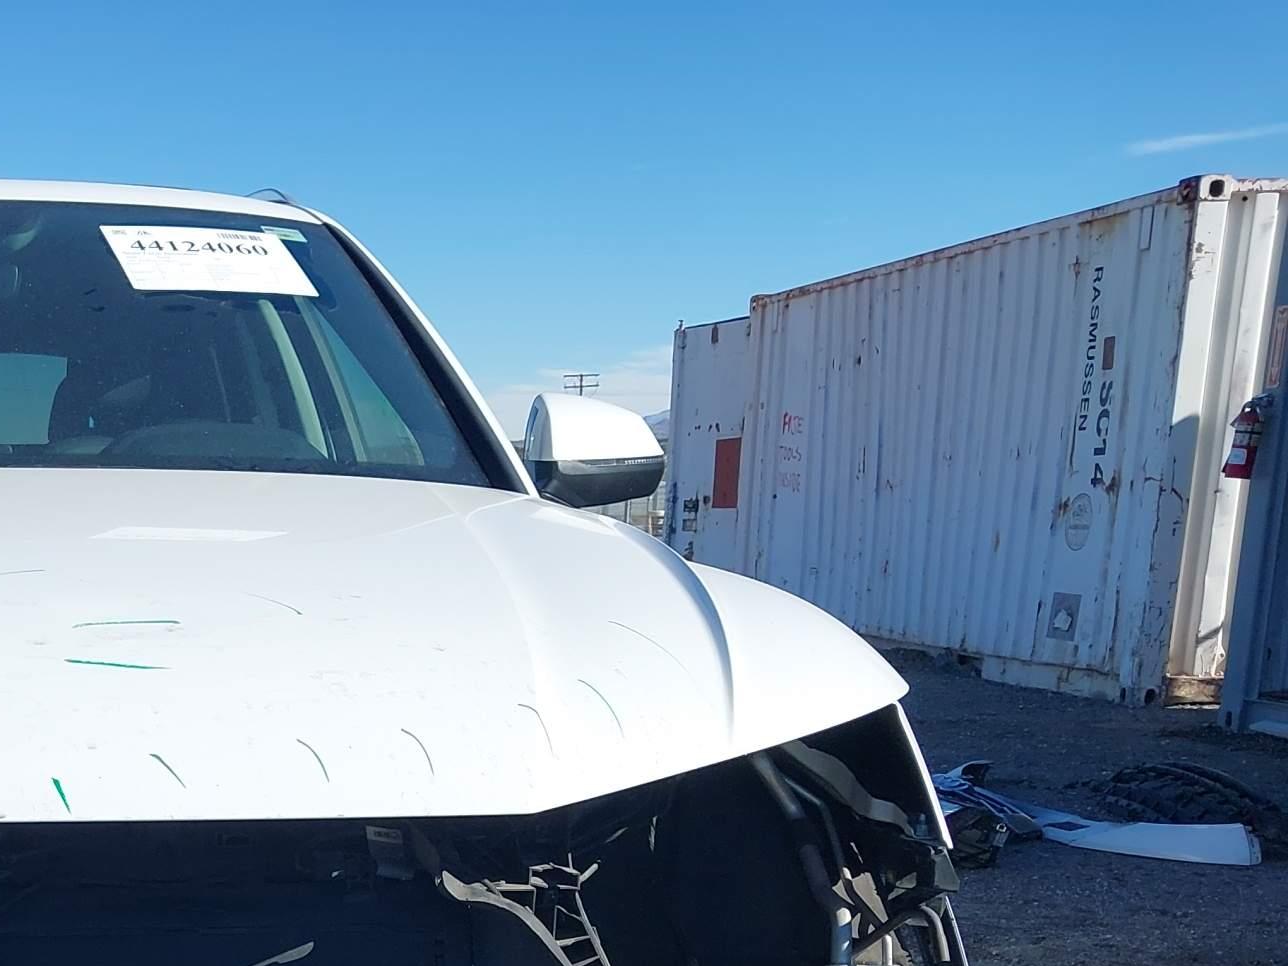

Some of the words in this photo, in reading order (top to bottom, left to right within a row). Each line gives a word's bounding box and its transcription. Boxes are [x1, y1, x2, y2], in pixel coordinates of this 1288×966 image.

[130, 239, 269, 256] 44124060
[1078, 266, 1104, 431] RASMUSSEN
[1091, 380, 1114, 488] SC14
